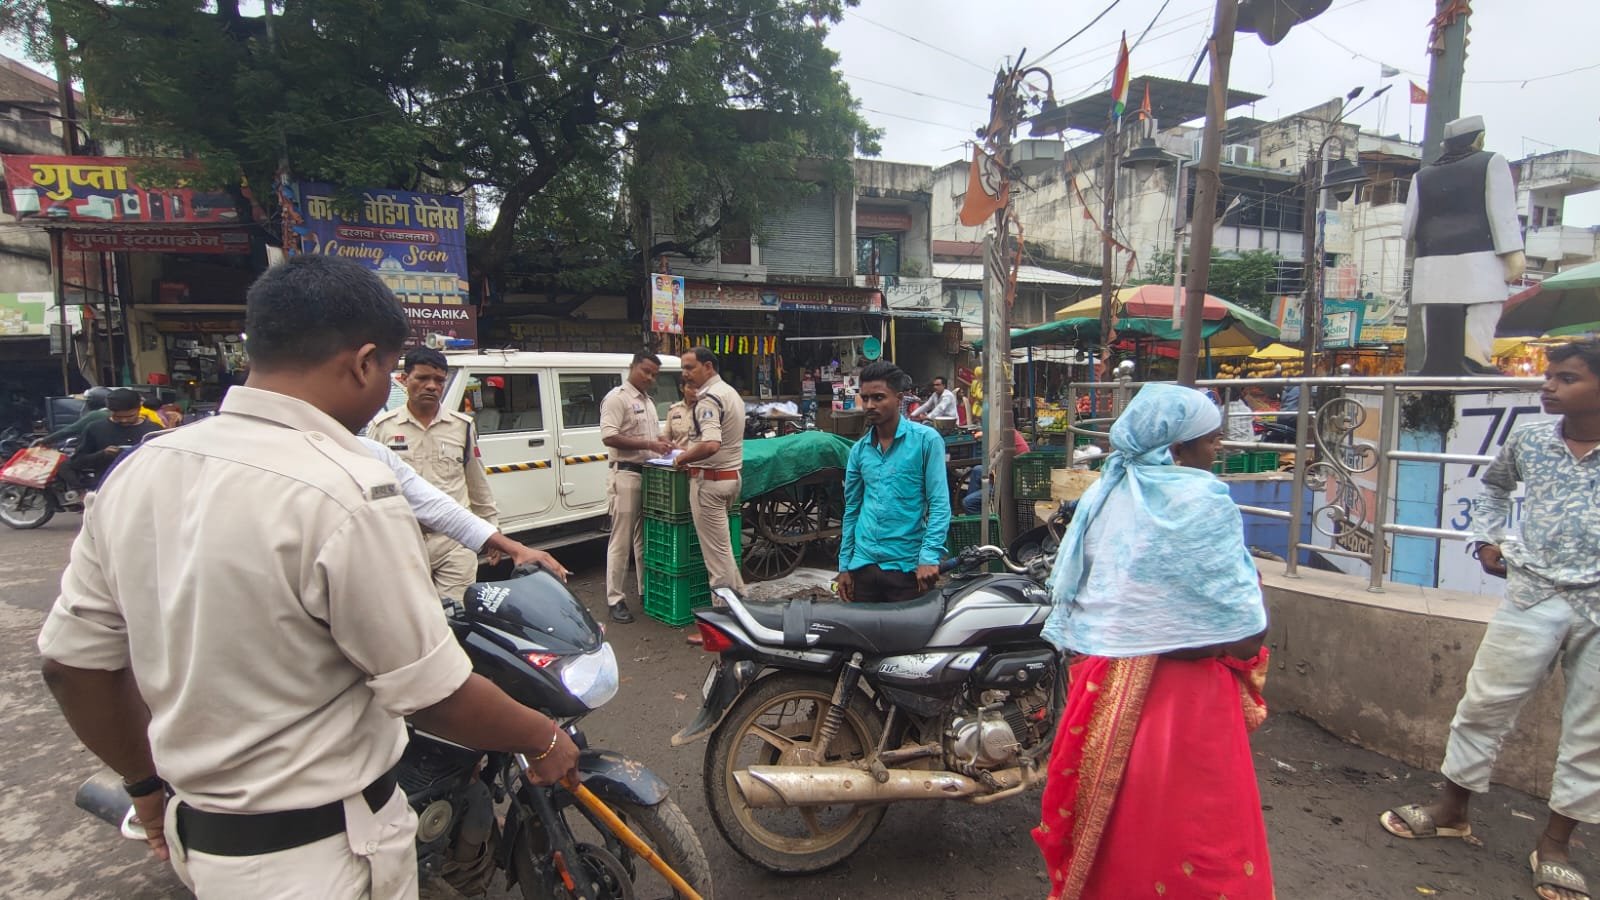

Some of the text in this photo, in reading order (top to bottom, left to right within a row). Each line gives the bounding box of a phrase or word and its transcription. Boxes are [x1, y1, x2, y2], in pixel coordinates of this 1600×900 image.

[29, 164, 128, 201] गुप्ता
[364, 193, 410, 226] वेडिंग
[412, 197, 459, 229] पैलेस
[72, 232, 118, 249] गुप्ता
[324, 240, 449, 266] Coming Soon
[1323, 325, 1348, 340] pollo
